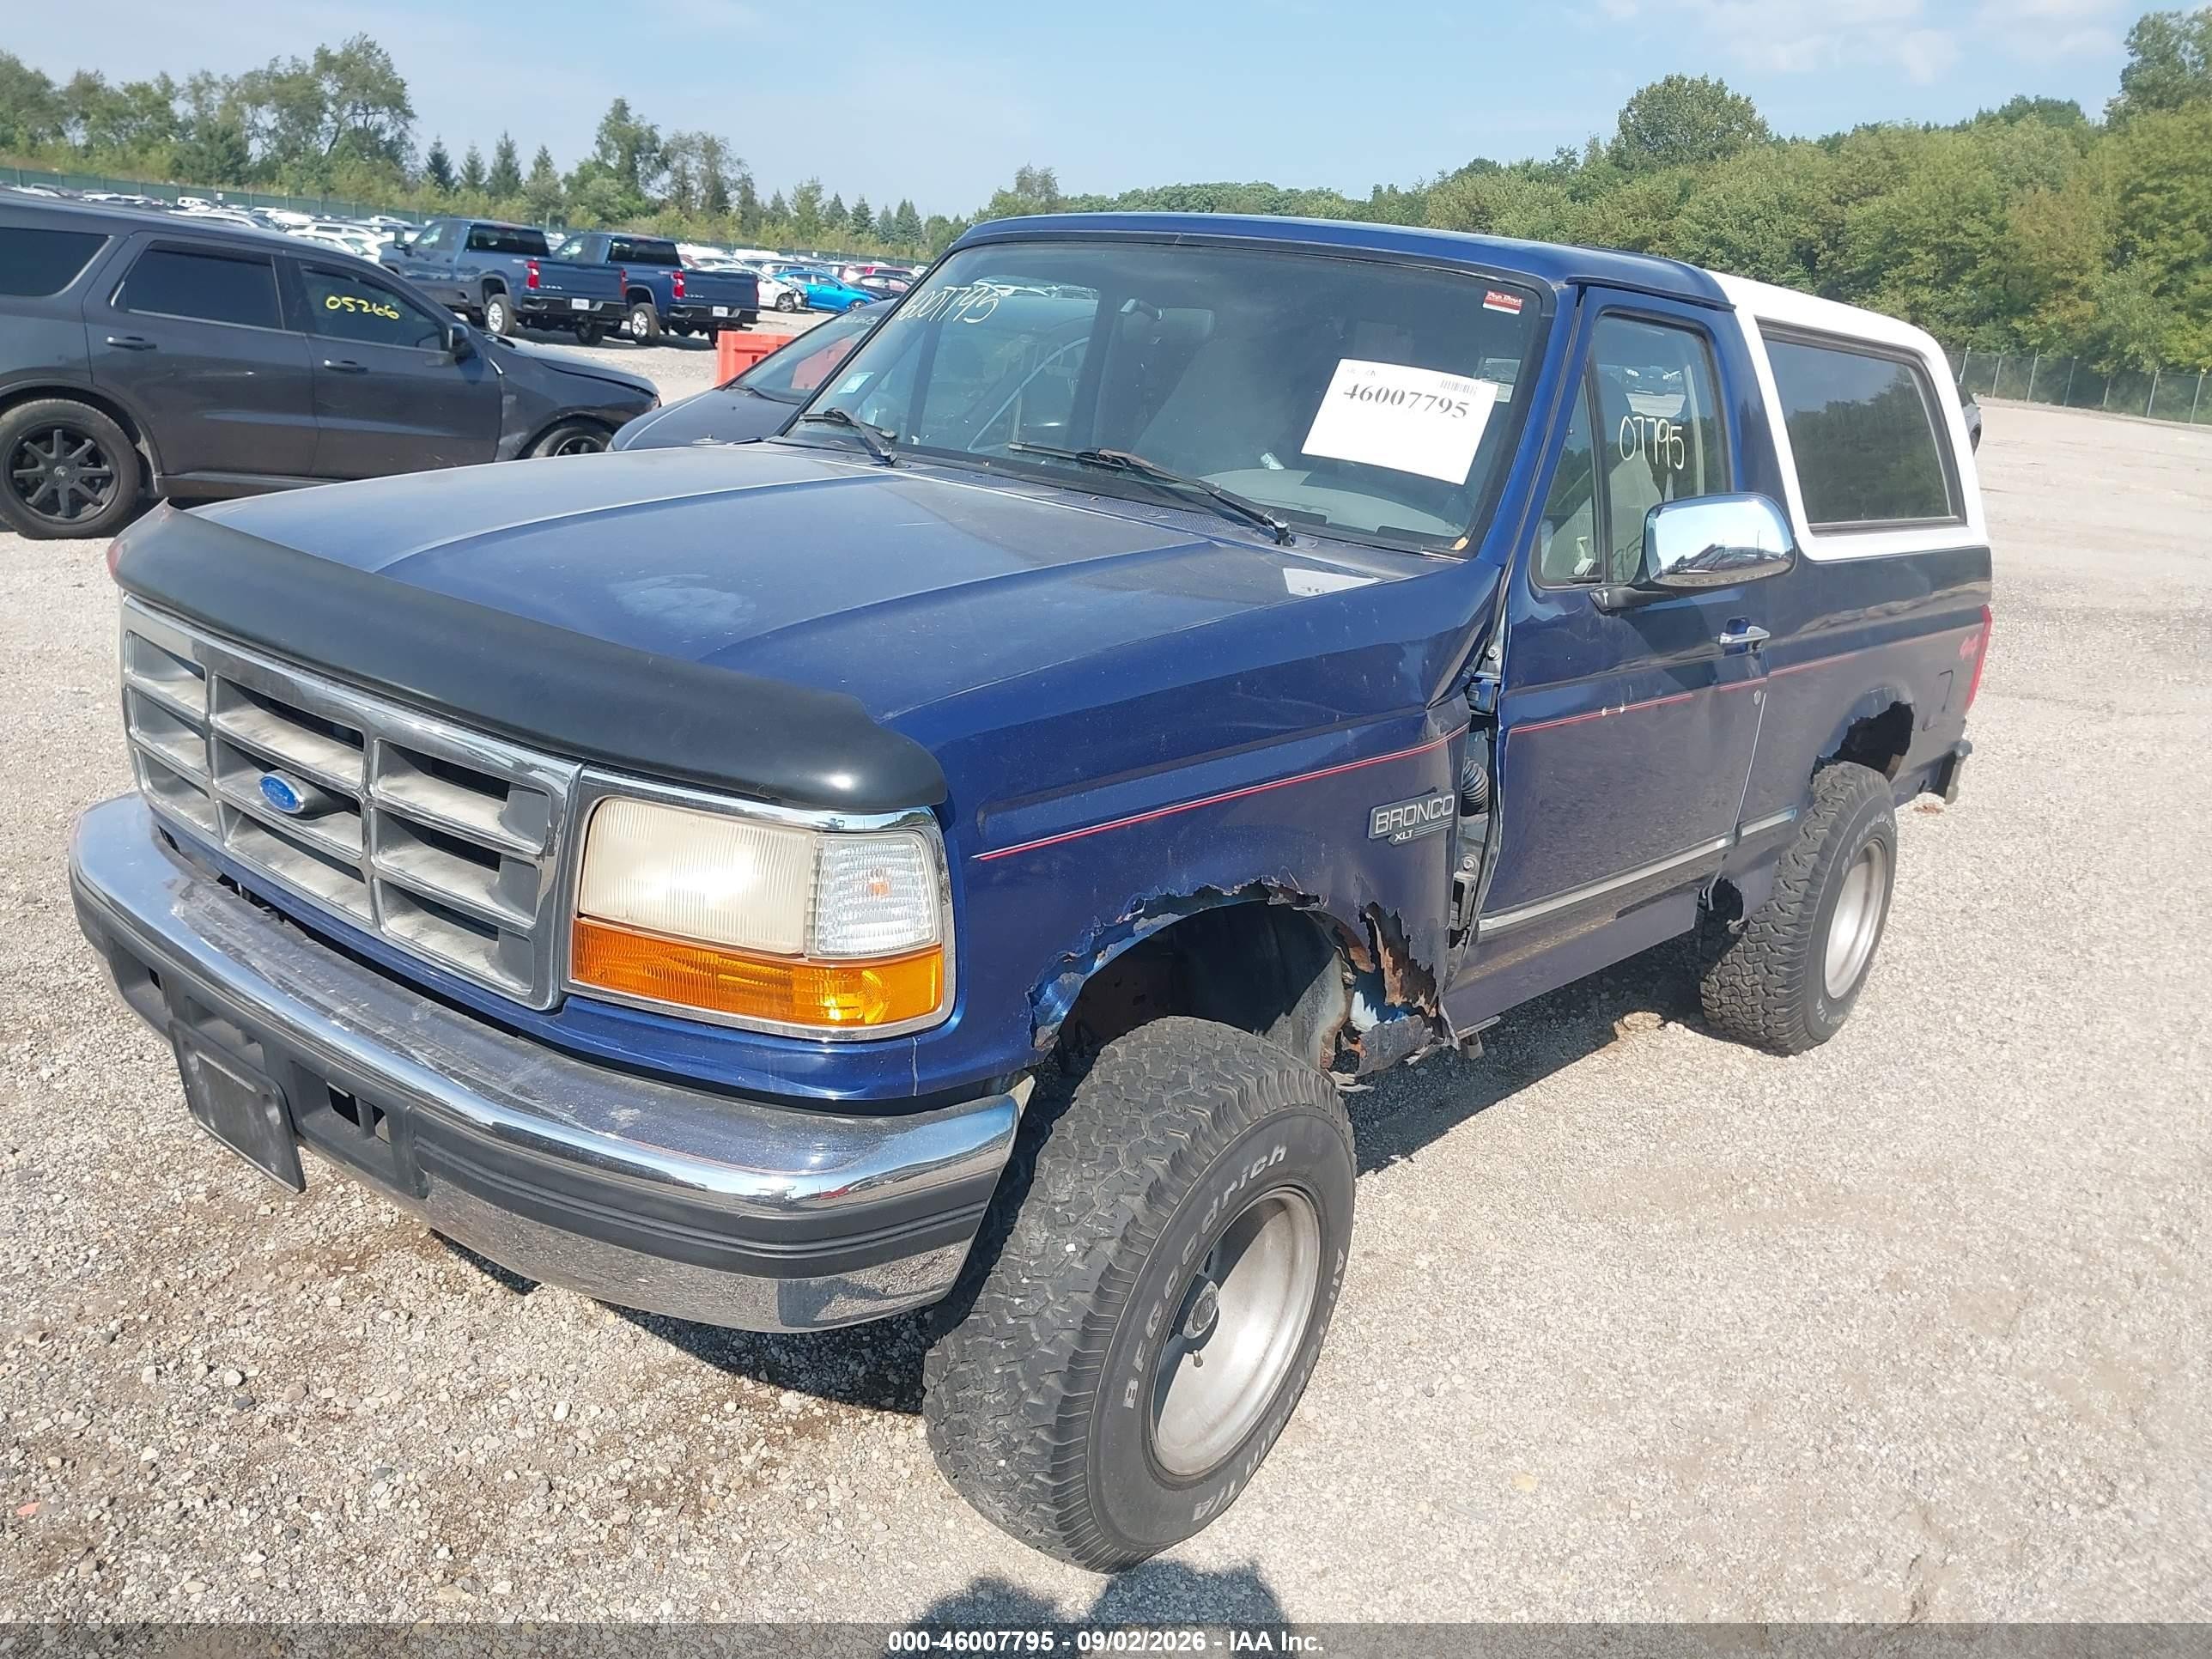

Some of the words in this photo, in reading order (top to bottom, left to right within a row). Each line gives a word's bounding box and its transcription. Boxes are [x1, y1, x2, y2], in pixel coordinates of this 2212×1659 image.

[1342, 383, 1470, 419] 46007795
[1620, 416, 1685, 470] 07795
[1375, 794, 1455, 834] BRONCO
[1395, 829, 1414, 842] XLT
[1122, 1145, 1287, 1409] BFGoodrich
